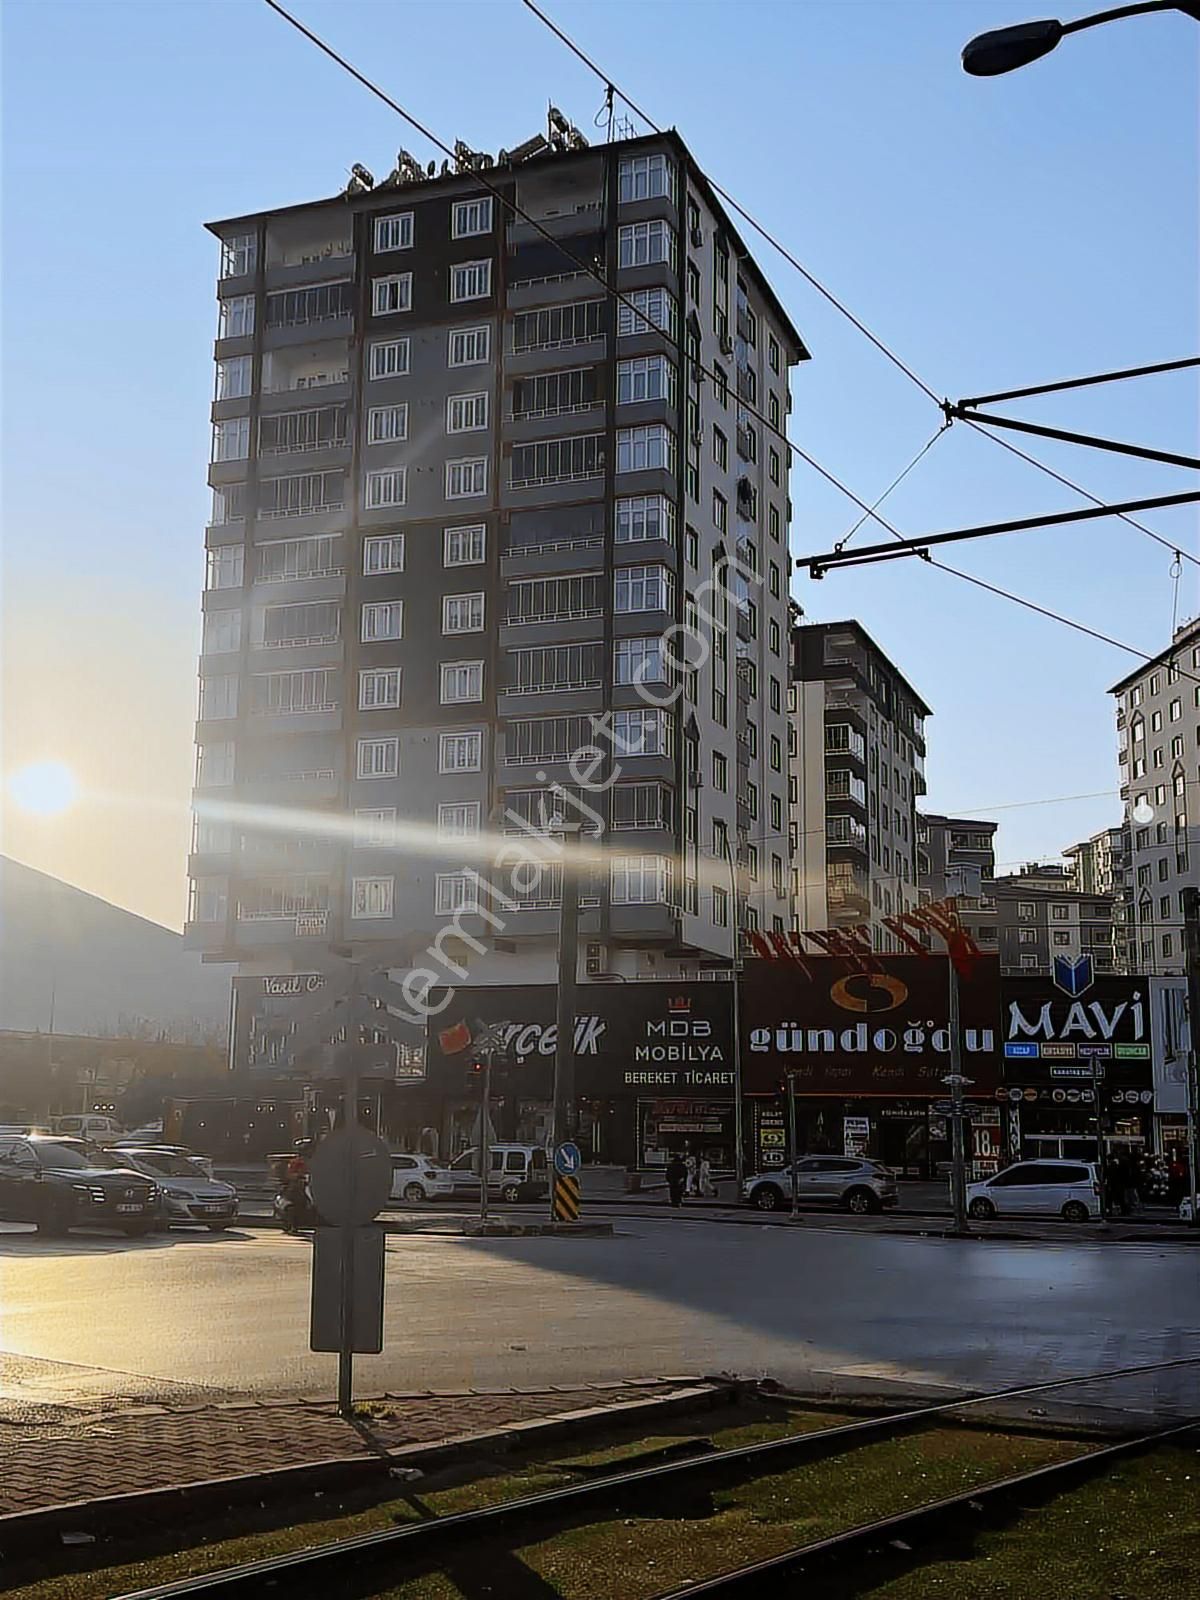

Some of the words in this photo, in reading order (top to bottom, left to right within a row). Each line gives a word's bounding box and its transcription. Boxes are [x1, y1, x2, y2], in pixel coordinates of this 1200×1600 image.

[646, 1020, 713, 1038] MDB
[749, 1019, 995, 1054] gündoğdu
[634, 1042, 724, 1062] MOBİLYA
[624, 1071, 678, 1085] BEREKET
[684, 1069, 736, 1085] TİCARET
